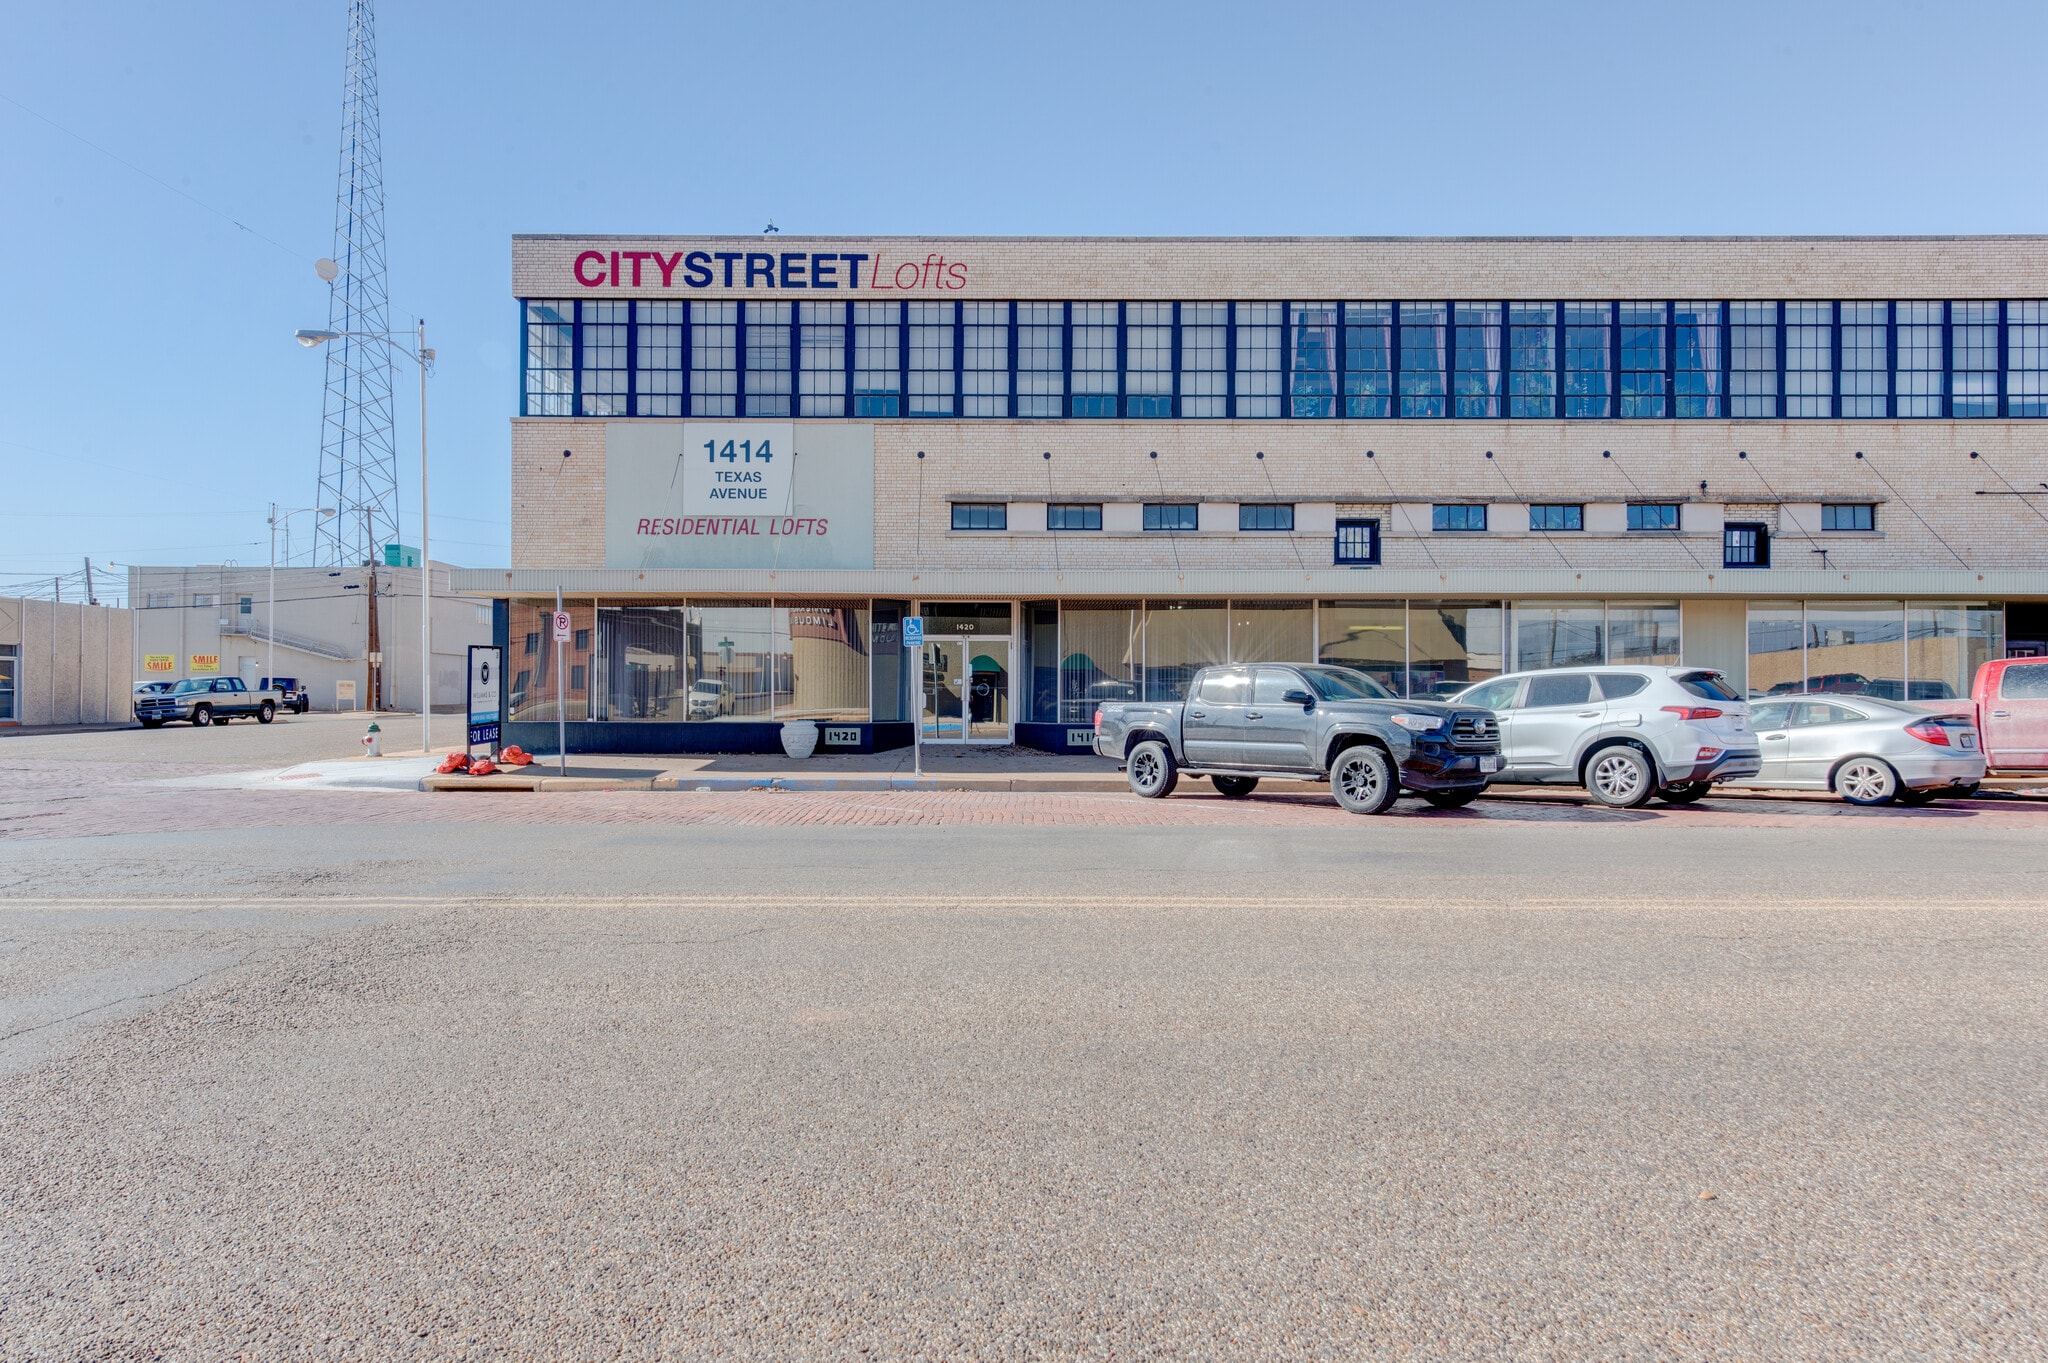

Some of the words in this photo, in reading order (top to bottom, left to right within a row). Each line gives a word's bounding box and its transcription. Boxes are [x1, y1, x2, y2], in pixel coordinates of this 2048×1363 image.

[702, 437, 775, 465] 1414
[715, 470, 763, 484] TEXAS
[708, 486, 769, 501] AVENUE
[636, 517, 760, 536] RESIDENTIAL
[769, 517, 829, 536] LOFTS
[956, 623, 975, 631] 1420
[147, 661, 173, 670] SMILE
[192, 655, 218, 664] SMILE
[482, 727, 499, 740] LEASE
[828, 731, 857, 742] 1420
